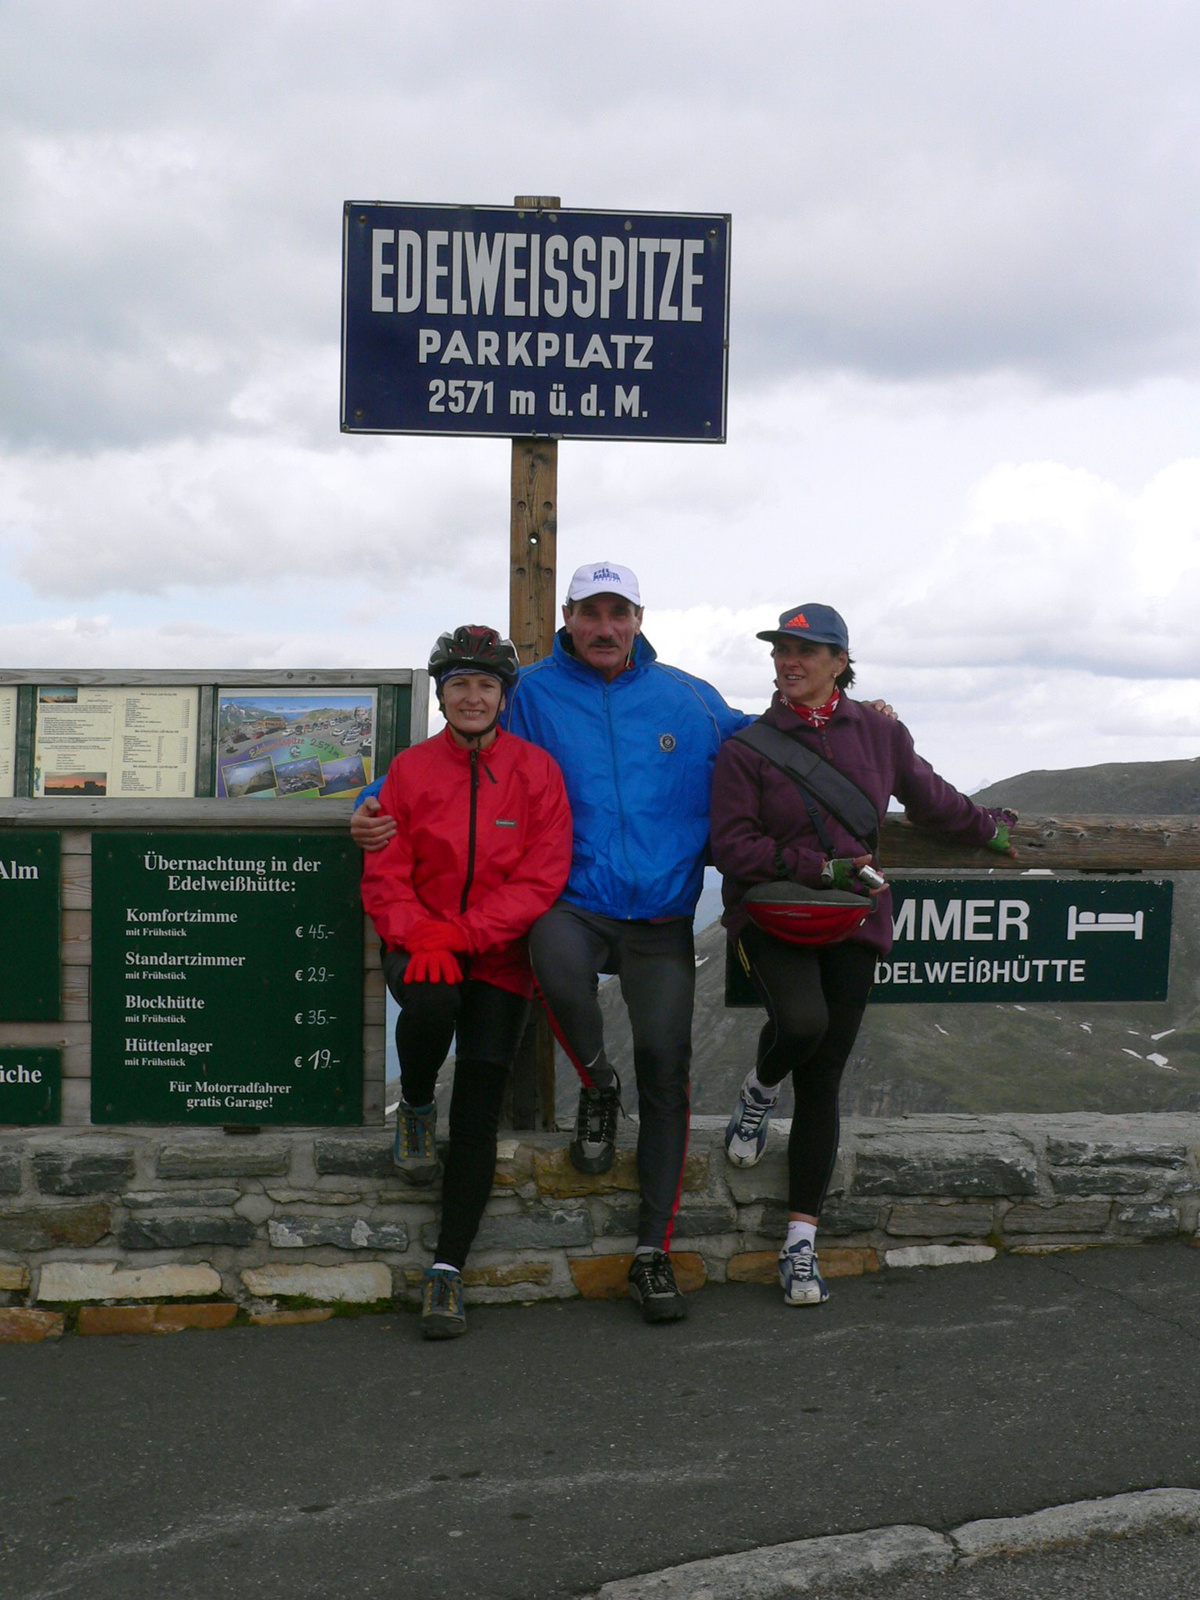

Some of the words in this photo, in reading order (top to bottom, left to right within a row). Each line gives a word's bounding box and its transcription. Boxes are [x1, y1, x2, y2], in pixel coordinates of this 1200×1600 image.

[370, 228, 705, 322] EDELWEISSPITZE
[418, 328, 654, 370] PARKPLATZ
[428, 378, 494, 414] 2571
[509, 389, 536, 415] m
[614, 384, 648, 418] M.
[144, 850, 267, 876] Übernachtung
[271, 856, 288, 872] in
[292, 856, 322, 872] der
[167, 875, 296, 892] Edelweißhütte:
[125, 907, 238, 923] Komfortzimme
[125, 927, 140, 937] mit
[143, 927, 187, 937] Frühstück
[295, 926, 304, 938] €
[125, 951, 246, 967] Standartzimmer
[125, 970, 140, 980] mit
[142, 970, 187, 981] Frühstück
[294, 969, 304, 982] €
[125, 994, 205, 1010] Blockhütte
[125, 1014, 140, 1024] mit
[142, 1014, 187, 1024] Frühstück
[294, 1012, 304, 1025] €
[124, 1038, 213, 1056] Hüttenlager
[124, 1057, 139, 1067] mit
[141, 1057, 186, 1067] Frühstück
[294, 1056, 303, 1068] €
[169, 1080, 192, 1093] Für
[195, 1081, 292, 1094] Motorradfahrer
[186, 1095, 222, 1110] gratis
[224, 1096, 274, 1111] Garage!
